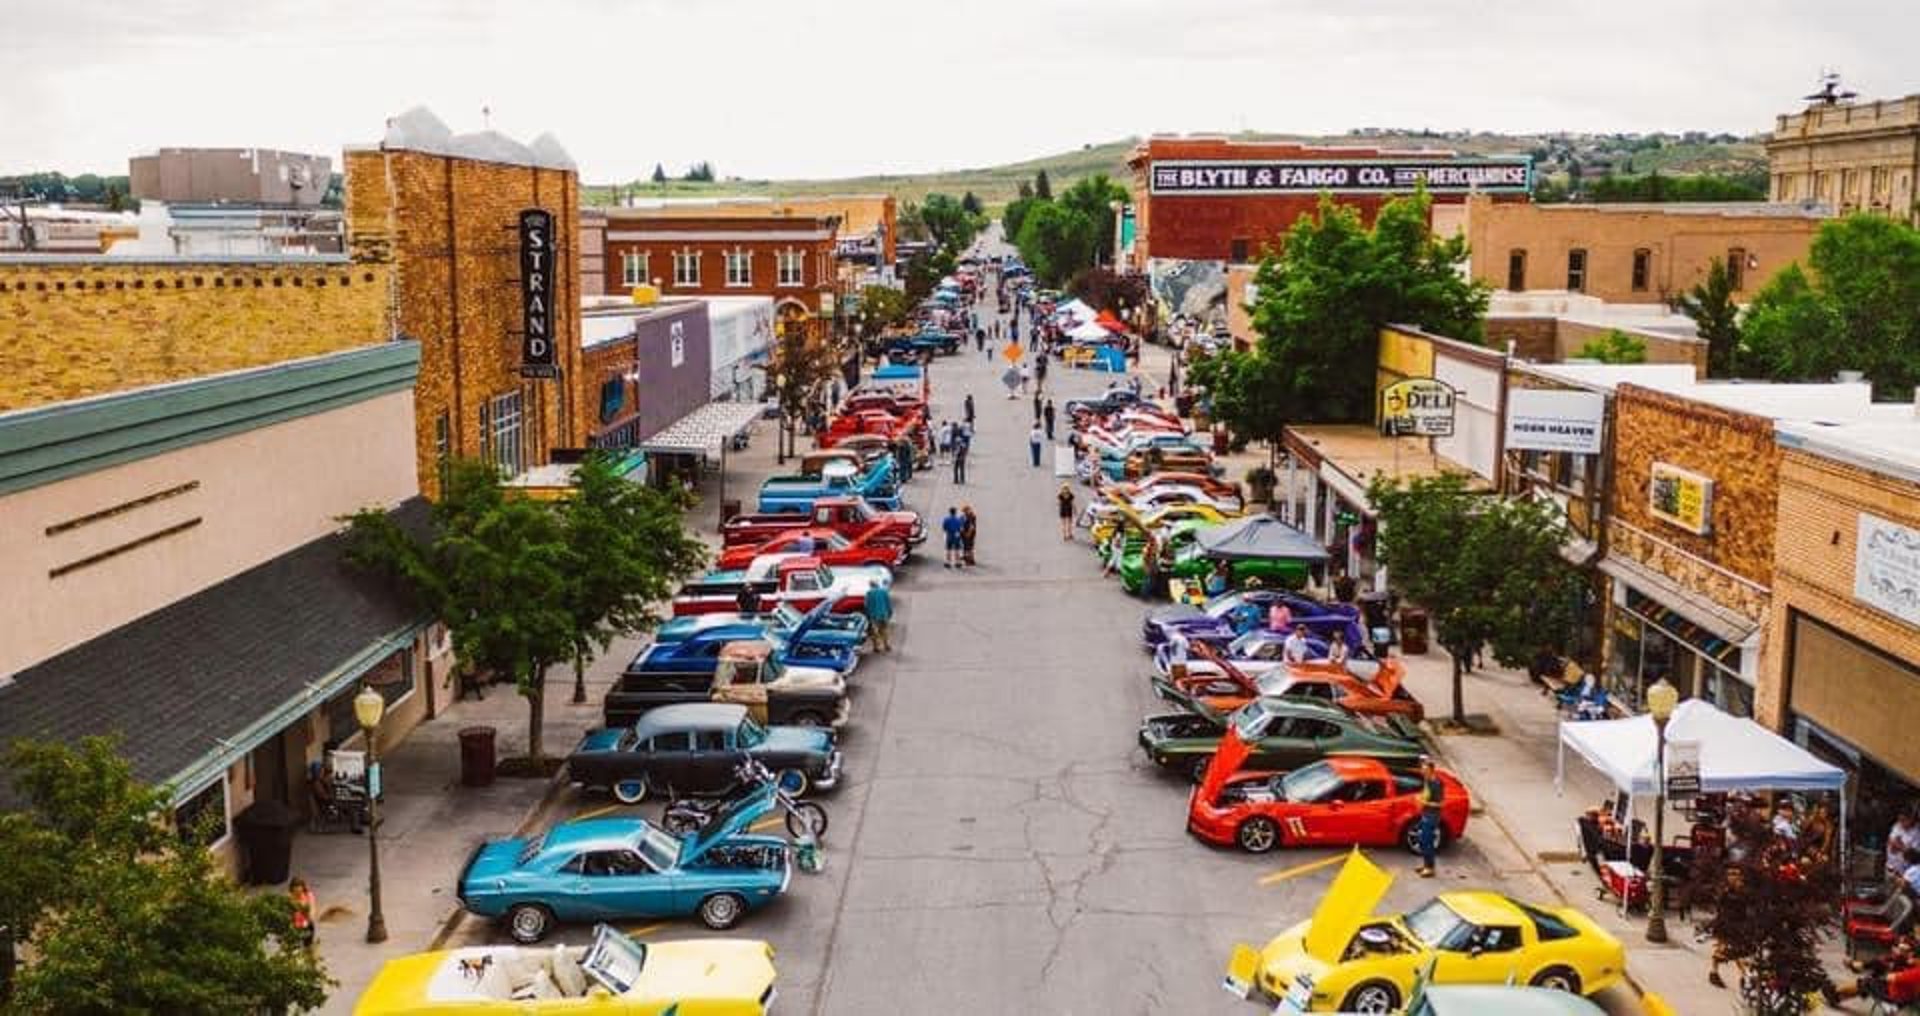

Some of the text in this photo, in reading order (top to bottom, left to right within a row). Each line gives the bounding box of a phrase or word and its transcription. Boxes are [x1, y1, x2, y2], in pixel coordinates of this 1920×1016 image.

[1157, 169, 1179, 186] THE
[1181, 168, 1248, 186] BLYTH
[1253, 169, 1274, 186] &
[1279, 168, 1348, 186] FARGO
[528, 229, 546, 357] STRAND
[1406, 391, 1451, 409] DELI
